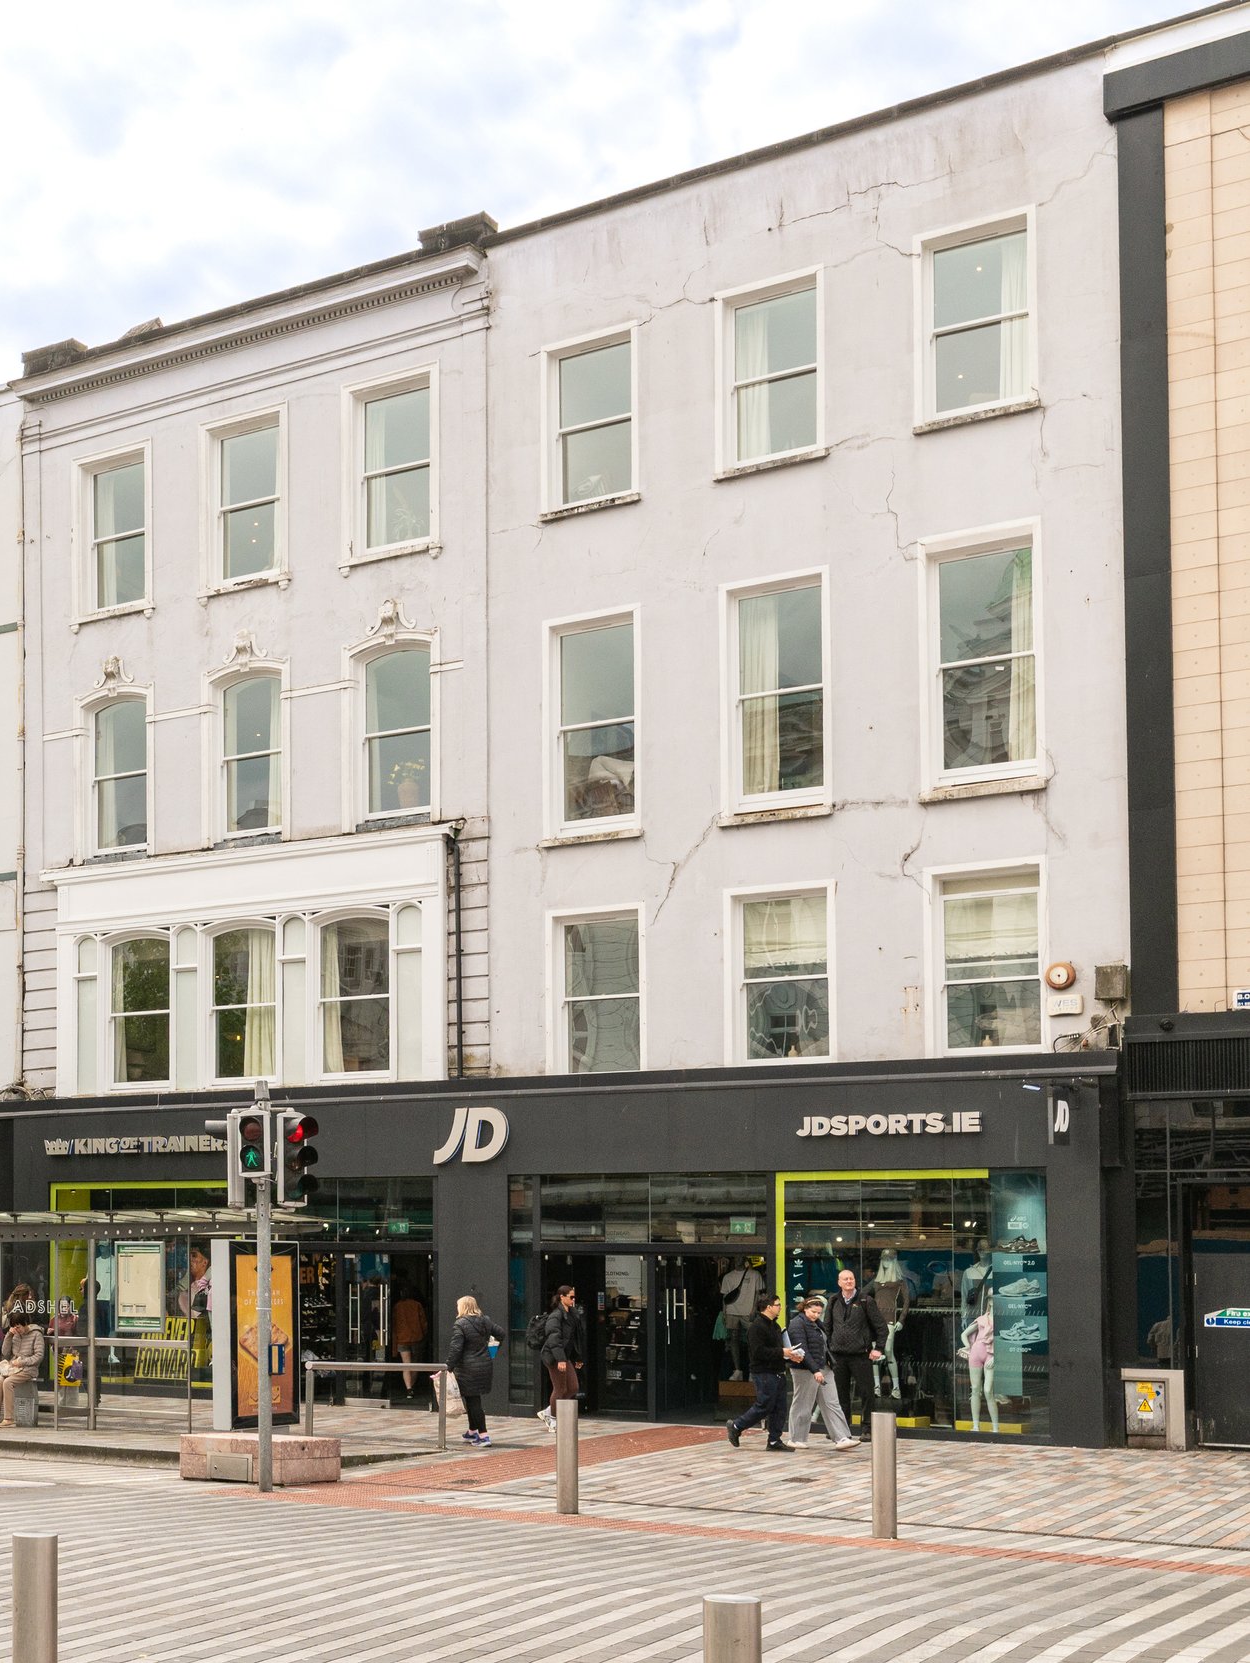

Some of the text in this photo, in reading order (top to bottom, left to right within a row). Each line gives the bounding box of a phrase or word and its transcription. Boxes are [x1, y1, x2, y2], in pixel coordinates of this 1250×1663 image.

[796, 1111, 982, 1137] JDSPORTS.IE
[1054, 1100, 1070, 1132] JD
[74, 1138, 120, 1155] KING
[120, 1137, 140, 1153] OF
[433, 1107, 510, 1164] JD
[12, 1299, 79, 1314] ADSHEL
